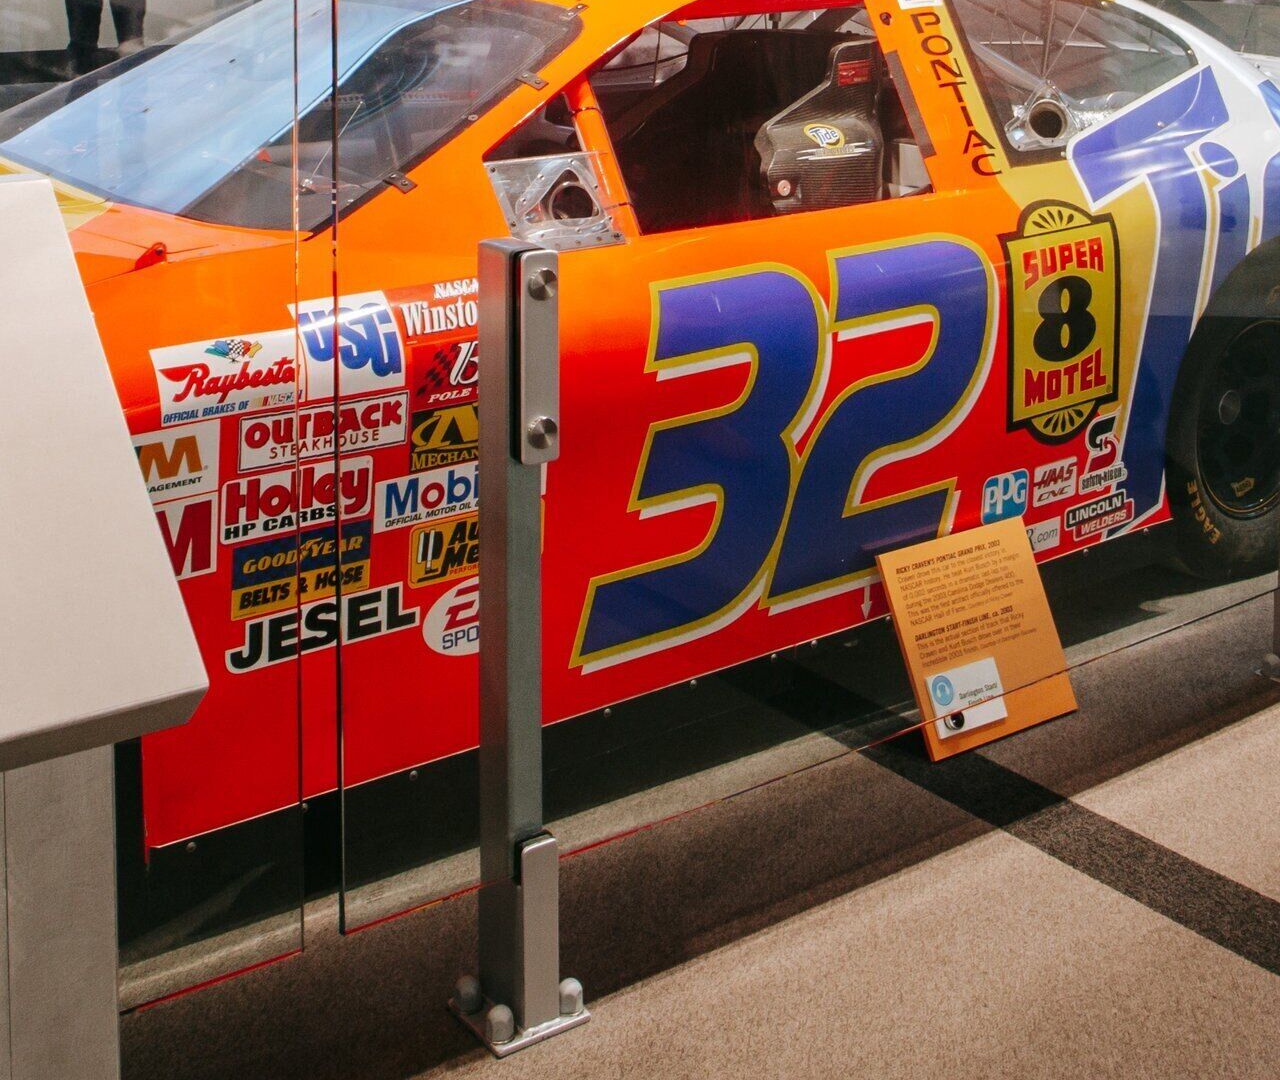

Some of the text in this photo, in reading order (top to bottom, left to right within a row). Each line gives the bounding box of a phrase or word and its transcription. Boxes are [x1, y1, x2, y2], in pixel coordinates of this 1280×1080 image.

[909, 11, 1003, 176] PONTIAC
[809, 126, 839, 146] Tide
[1022, 235, 1105, 291] SUPER
[400, 297, 479, 337] Winsto
[1033, 274, 1093, 362] 8
[298, 302, 402, 378] USG
[427, 388, 473, 404] POLE
[1022, 348, 1107, 408] MOTEL
[162, 408, 199, 425] OFFICIAL
[202, 403, 236, 418] BRAKES
[238, 399, 250, 411] OF
[245, 400, 403, 449] OUTBACK
[140, 435, 203, 481] M
[269, 428, 381, 460] STEAKHOUSE
[568, 232, 999, 675] 32
[385, 470, 479, 519] Mobi
[984, 473, 1027, 515] PPG
[1034, 462, 1077, 490] HAAS
[1037, 485, 1072, 502] CNC
[225, 467, 370, 527] Holley
[385, 503, 473, 528] OFFICIAL MOTOR OIL
[1068, 495, 1122, 524] LINCOLN
[224, 504, 339, 541] HP CARBS
[1081, 508, 1127, 535] WELDERS
[242, 535, 364, 574] GOODYEAR
[895, 565, 911, 574] RICKY
[935, 552, 956, 562] PONTIAC
[957, 547, 973, 556] GRAND
[238, 565, 365, 611] BELTS & HOSE
[900, 581, 923, 591] NASCAR
[230, 586, 418, 671] JESEL
[442, 626, 479, 650] SPO
[910, 615, 932, 626] NASCAR
[914, 627, 945, 641] DARLINGTON
